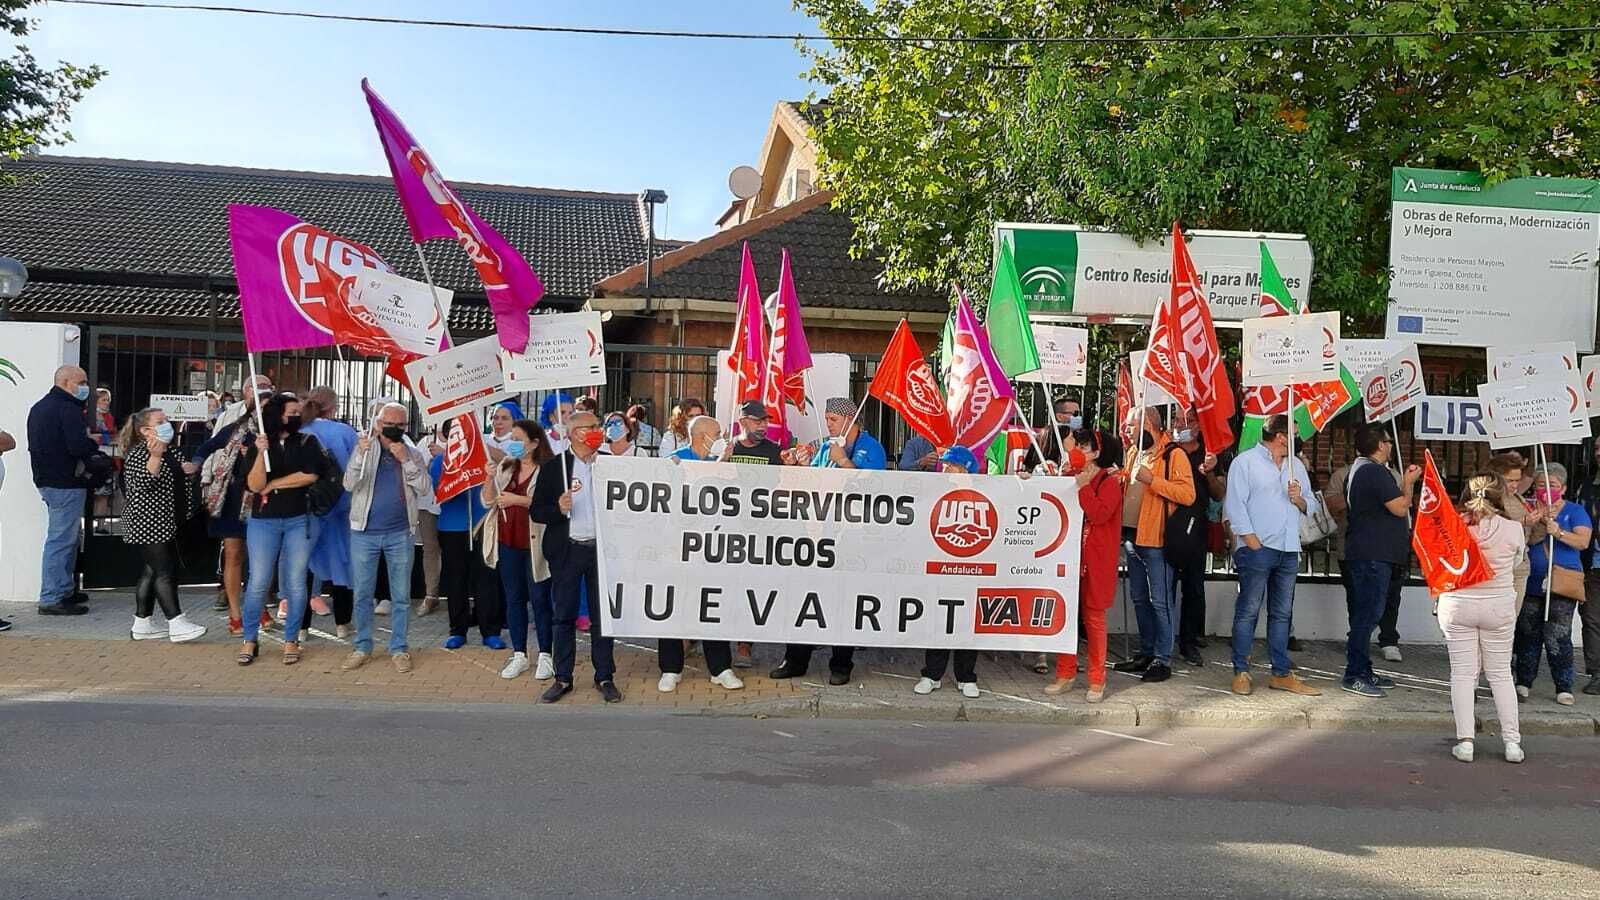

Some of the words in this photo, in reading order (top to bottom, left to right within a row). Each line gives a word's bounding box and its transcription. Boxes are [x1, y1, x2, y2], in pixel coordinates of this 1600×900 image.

[1420, 182, 1439, 190] Junta
[1448, 184, 1481, 192] Andalucía
[1403, 208, 1437, 221] Obras
[1438, 210, 1453, 222] de
[1455, 212, 1507, 227] Reforma,
[1509, 214, 1590, 231] Modernización
[1404, 224, 1412, 236] y
[1414, 224, 1452, 237] Mejora
[1447, 256, 1477, 266] Personas
[1084, 266, 1129, 282] Centro
[1133, 267, 1208, 285] Residal
[1211, 274, 1241, 288] para
[1245, 273, 1301, 289] Mares
[1209, 291, 1248, 307] Parque
[1421, 401, 1488, 436] LIR
[606, 480, 672, 513] POR
[681, 484, 741, 517] LOS
[750, 488, 915, 525] SERVICIOS
[938, 500, 990, 529] UGT
[1016, 506, 1041, 525] SP
[1003, 537, 1034, 546] Públicos
[1004, 528, 1037, 536] Servicios
[681, 525, 836, 569] PÚBLICOS
[940, 564, 983, 575] Andalucía
[1010, 565, 1043, 575] Córdoba
[978, 595, 1021, 627] YA
[1029, 595, 1056, 628] !!
